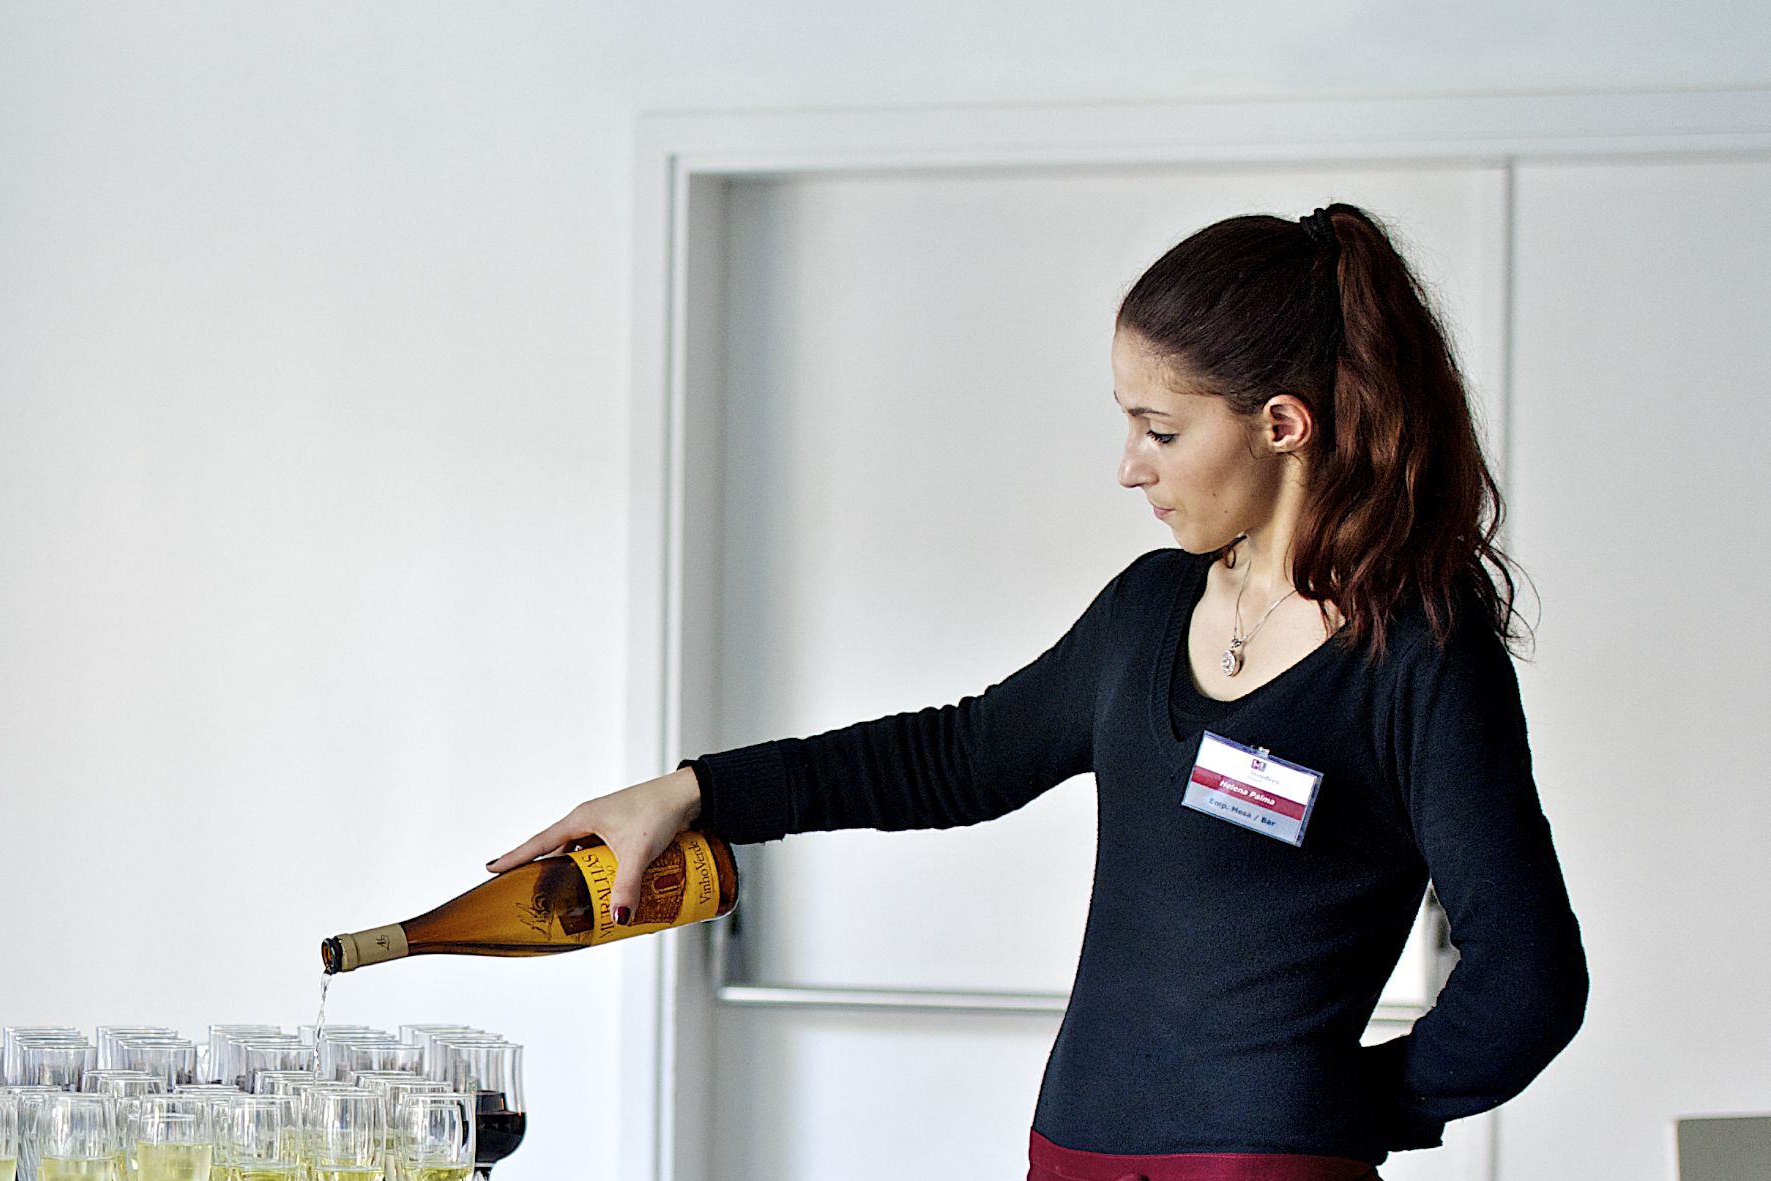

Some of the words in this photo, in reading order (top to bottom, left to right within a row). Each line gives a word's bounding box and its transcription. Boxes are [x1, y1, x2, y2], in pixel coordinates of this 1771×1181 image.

[1220, 780, 1248, 795] Helena
[1249, 791, 1275, 805] Palma
[1209, 798, 1228, 810] Emp.
[1231, 806, 1251, 818] Mesa
[1261, 816, 1275, 826] Bar
[582, 854, 615, 939] MURALHAS
